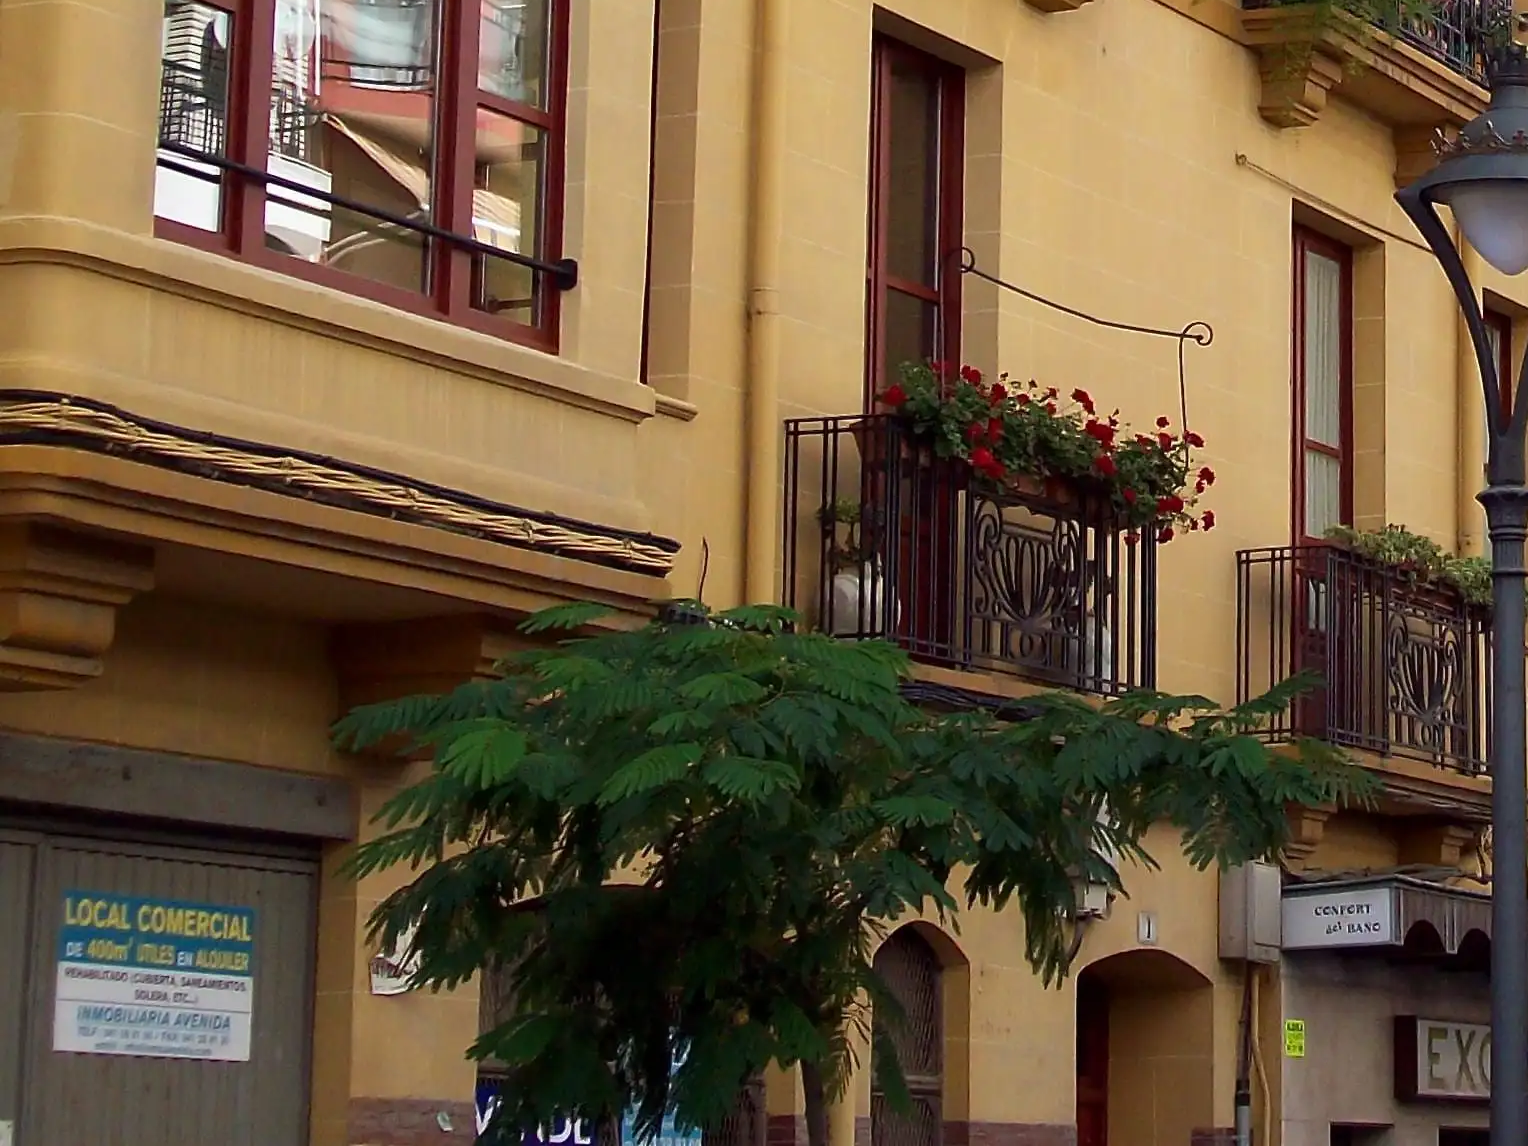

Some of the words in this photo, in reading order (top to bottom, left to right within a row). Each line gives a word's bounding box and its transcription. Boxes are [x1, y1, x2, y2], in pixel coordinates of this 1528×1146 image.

[65, 898, 130, 930] LOCAL
[138, 905, 251, 942] COMERCIAL
[1314, 904, 1372, 916] CONFORT
[1325, 921, 1342, 934] del
[66, 941, 84, 957] DE
[177, 951, 193, 966] EN
[196, 950, 249, 971] ALQUILER
[65, 967, 129, 982] REHABILITADO
[77, 1005, 170, 1026] INMOBILIARIA
[174, 1013, 231, 1030] AVENIDA
